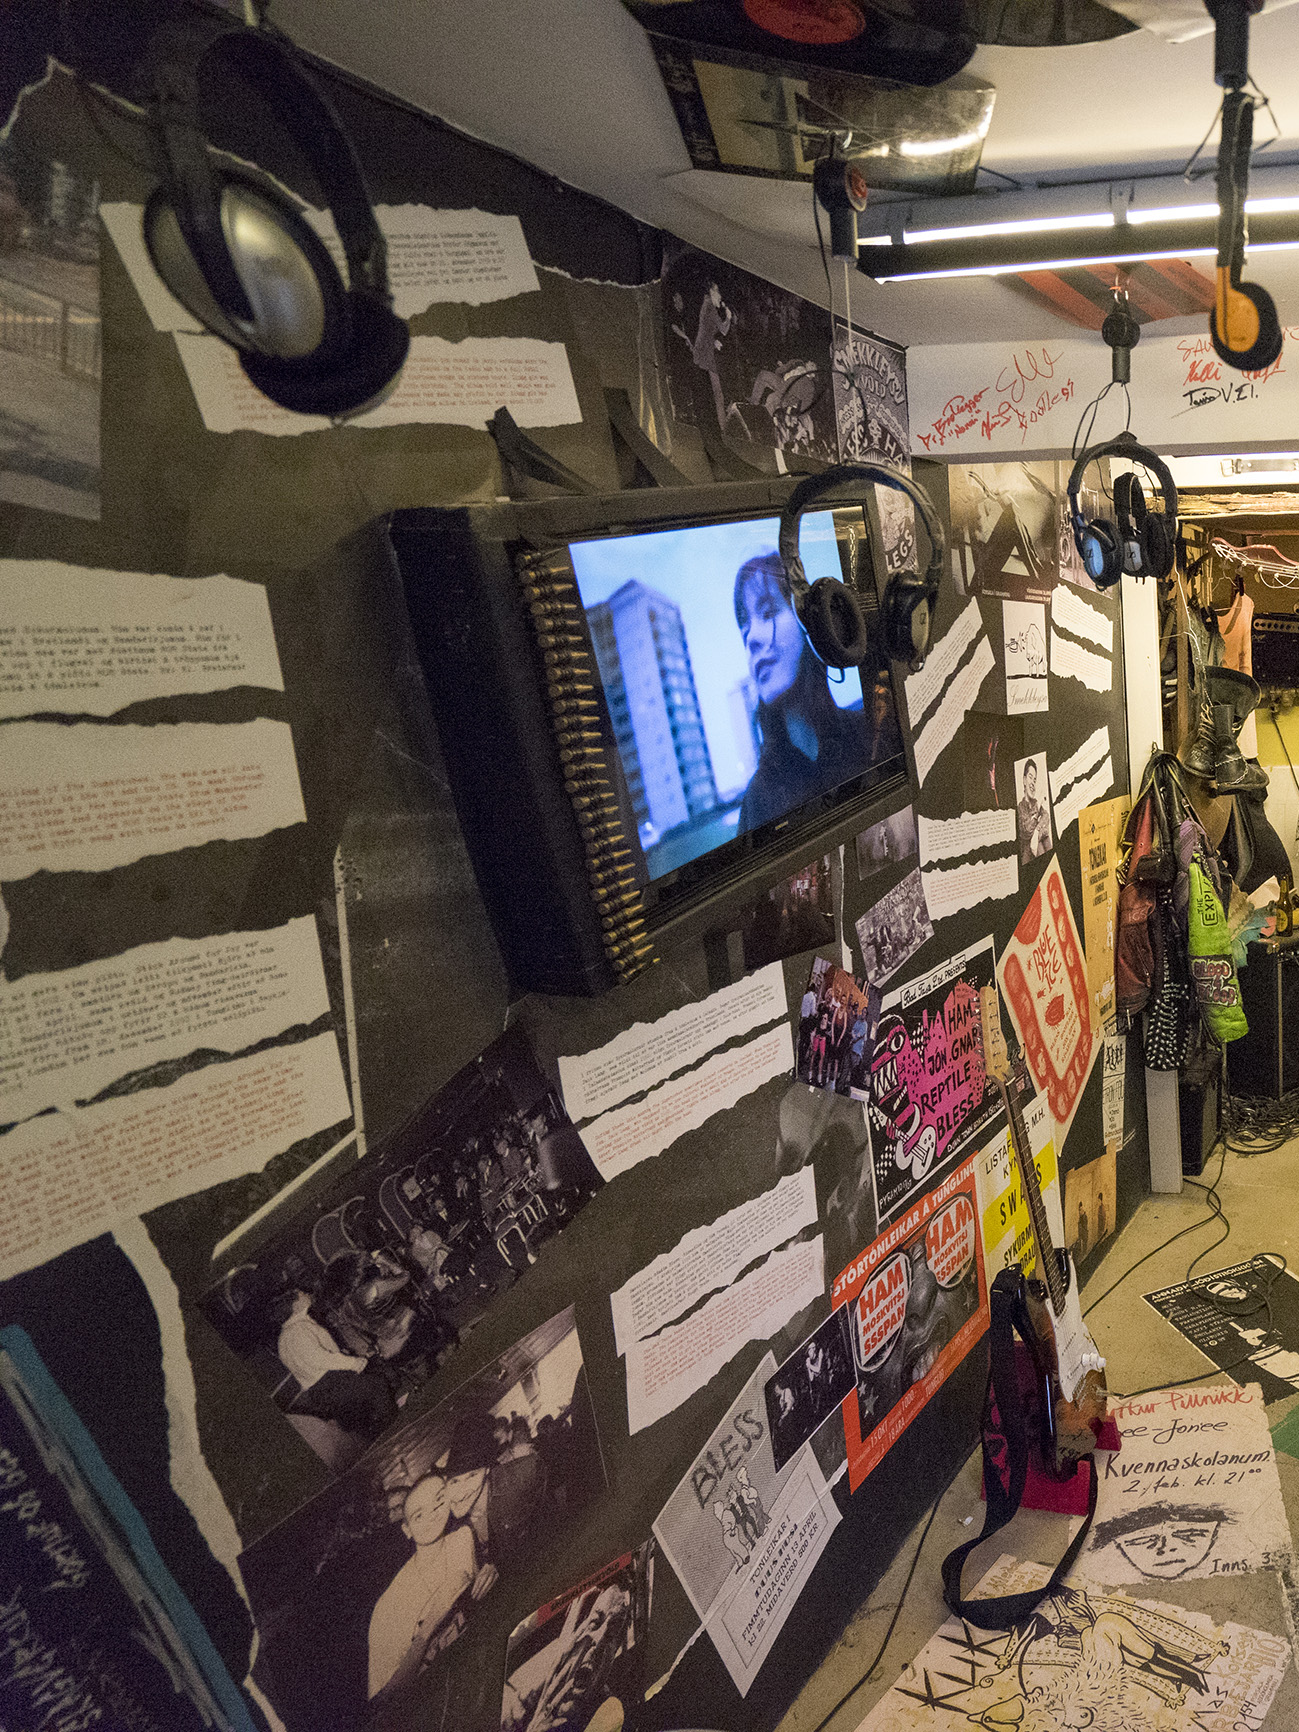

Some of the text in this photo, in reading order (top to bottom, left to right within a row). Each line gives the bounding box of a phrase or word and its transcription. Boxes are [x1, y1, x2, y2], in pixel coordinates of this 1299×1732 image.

[948, 999, 975, 1035] HAM
[921, 1060, 971, 1116] REPTILE
[936, 1092, 975, 1142] BLESS
[926, 1198, 974, 1261] HAM
[1004, 1222, 1033, 1268] SYKURM
[859, 1262, 905, 1322] HAM
[862, 1288, 906, 1337] MOSKVITSJ
[863, 1302, 906, 1357] SSSPAN
